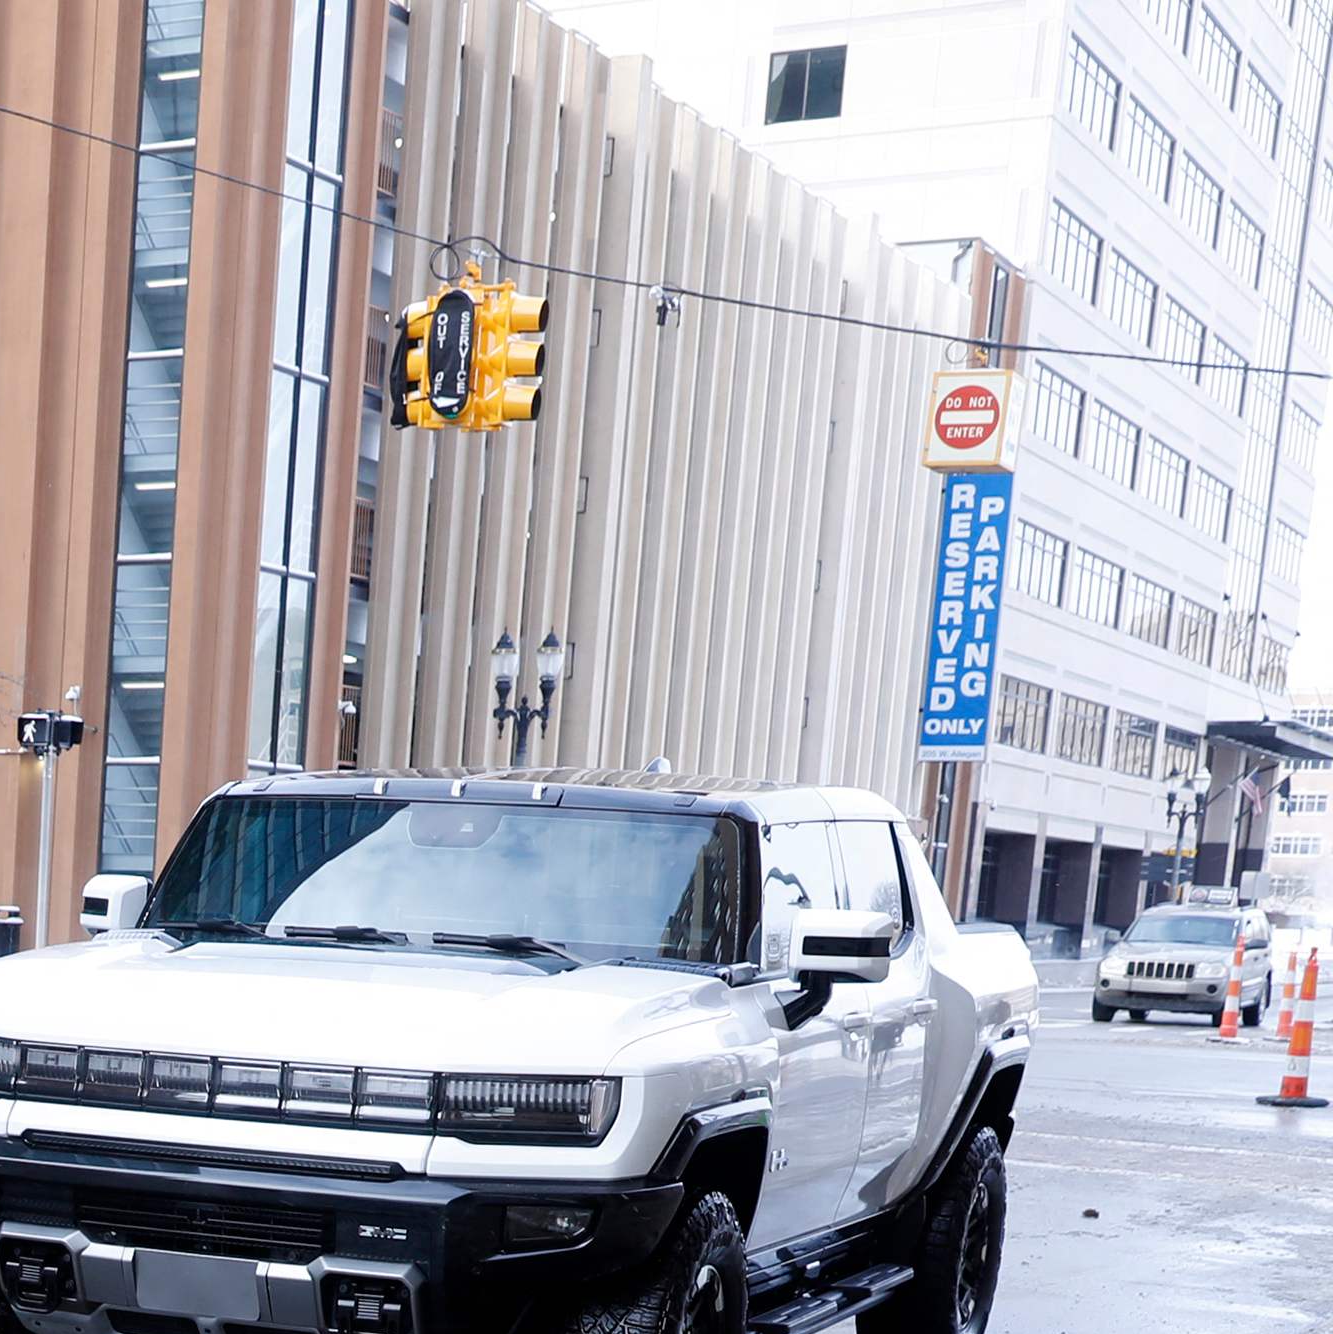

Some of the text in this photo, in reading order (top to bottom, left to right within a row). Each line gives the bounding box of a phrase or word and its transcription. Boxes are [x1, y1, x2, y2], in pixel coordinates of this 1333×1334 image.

[434, 313, 449, 394] OUT OF
[457, 311, 471, 394] SERVICE
[945, 396, 993, 409] DO NOT
[946, 426, 984, 439] ENTER
[929, 483, 977, 712] RESERVED
[960, 496, 1006, 698] PARKING
[924, 718, 984, 736] ONLY
[358, 1224, 408, 1240] GMC
